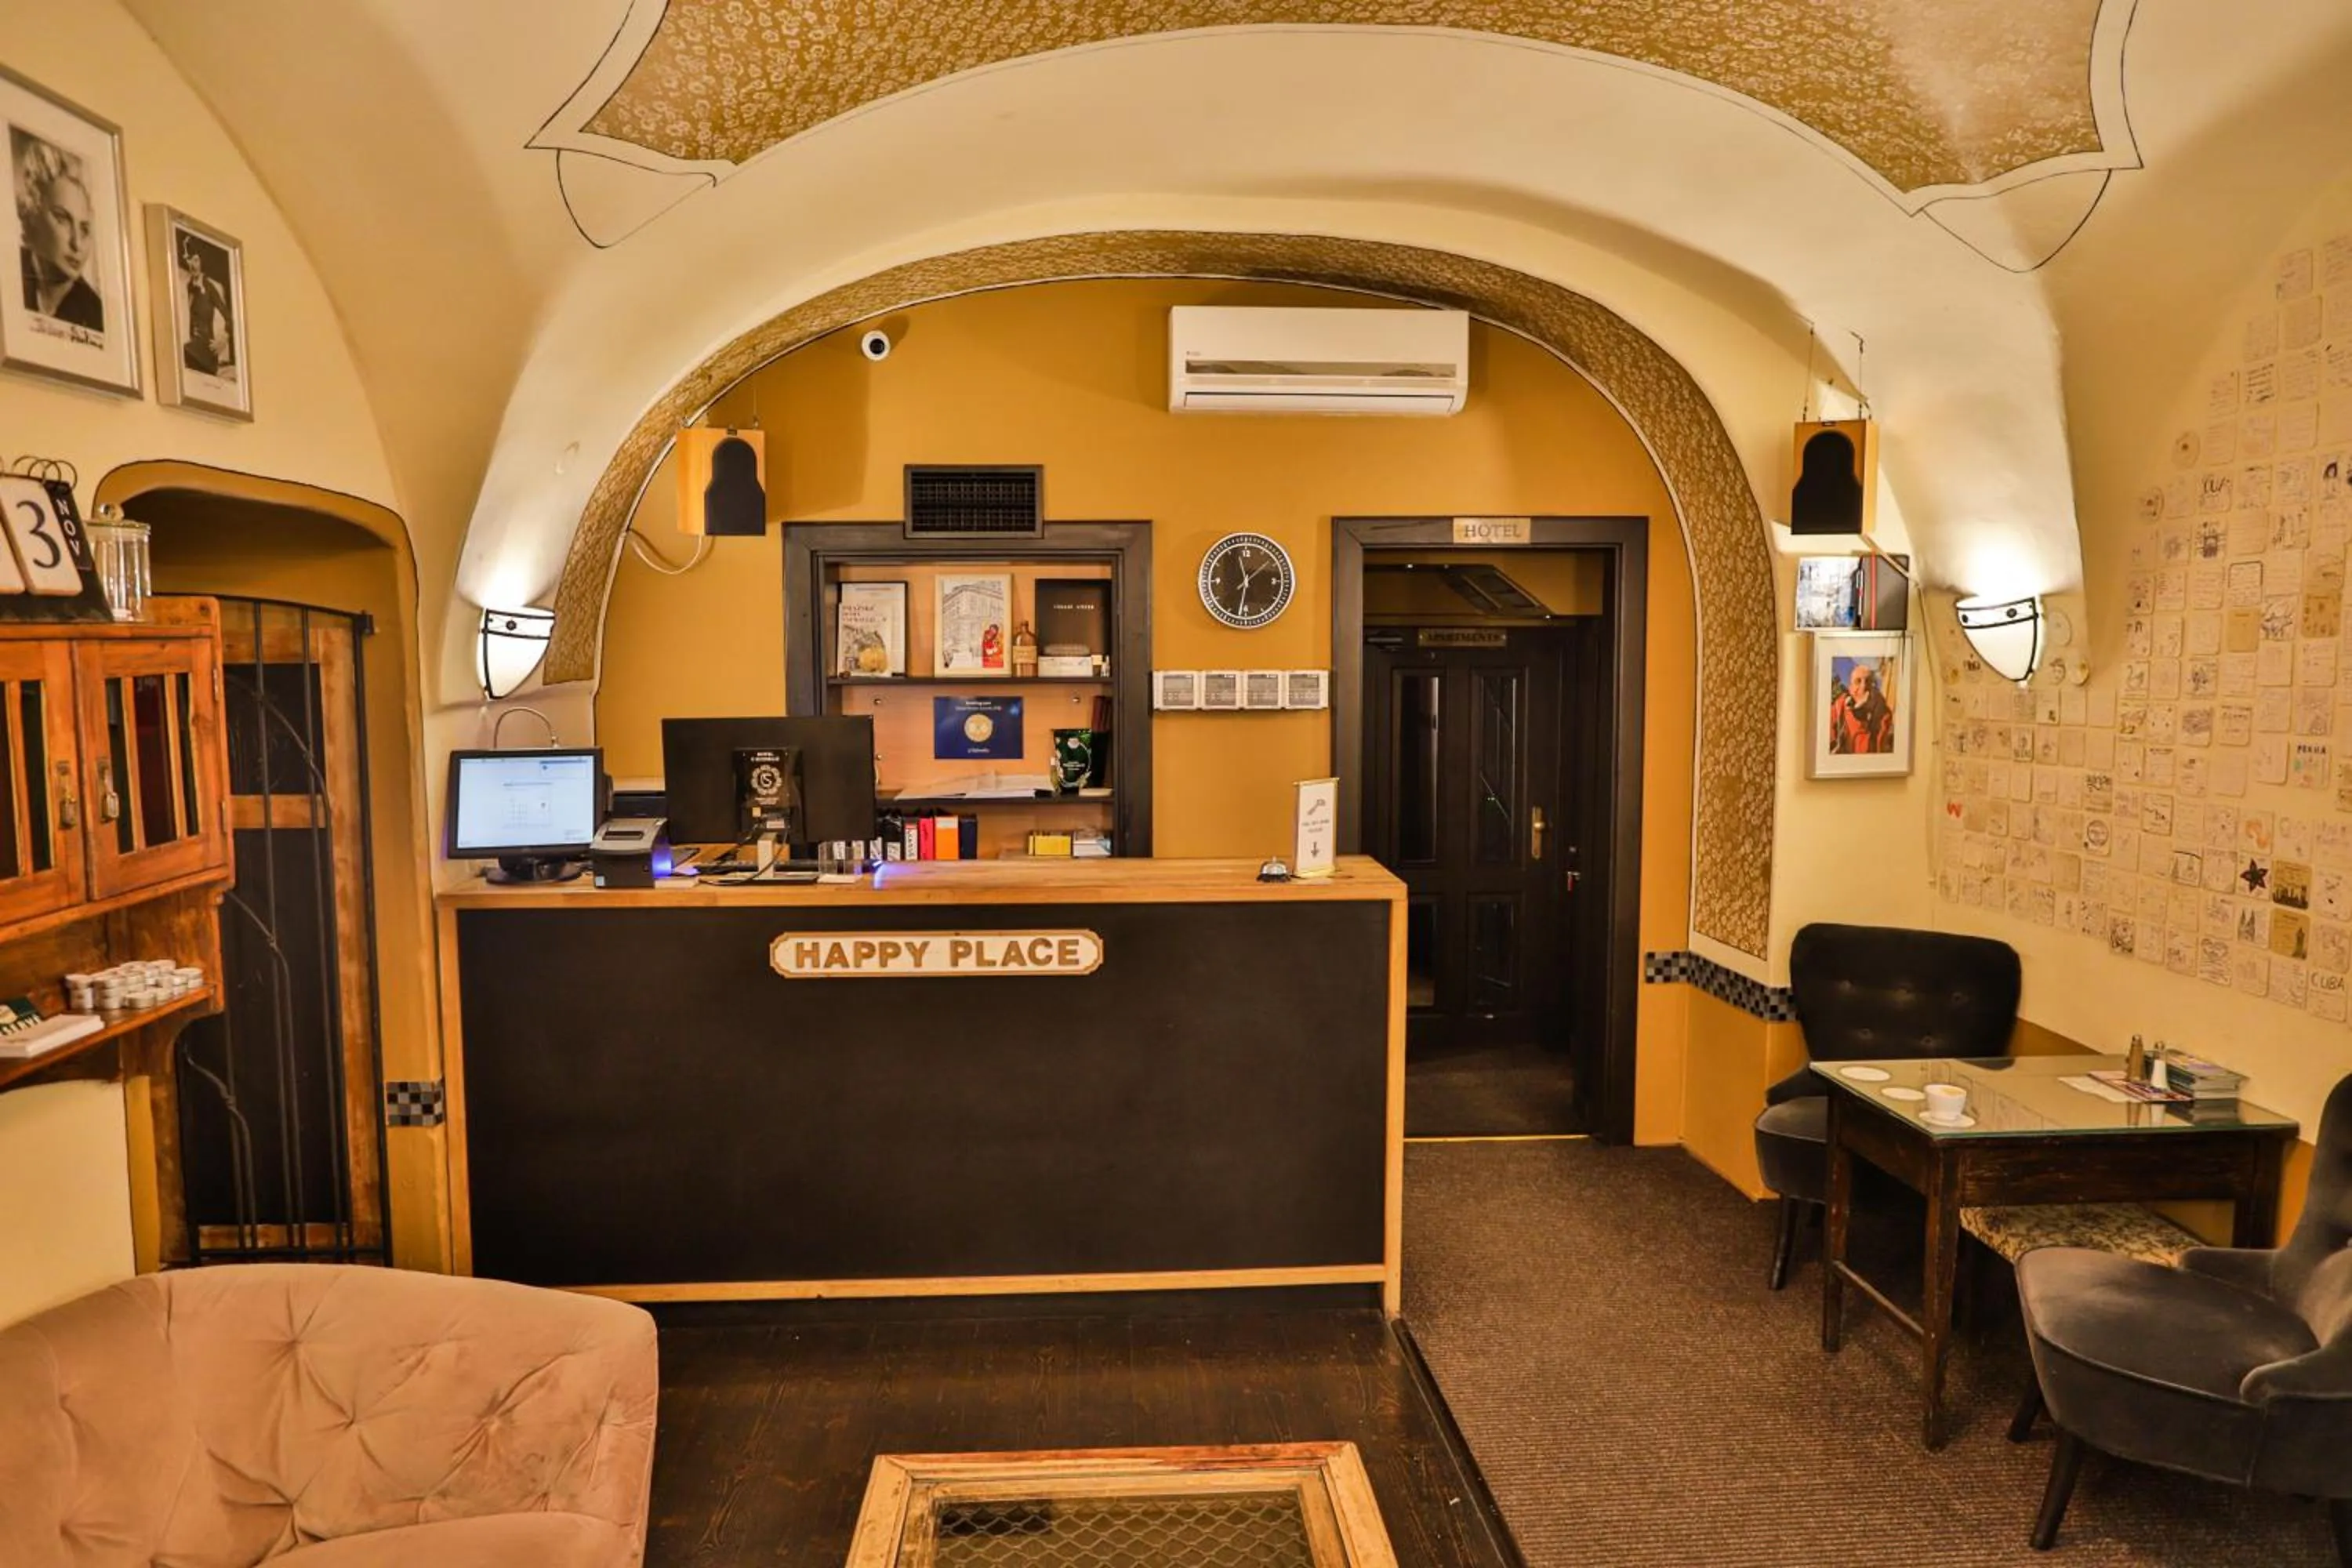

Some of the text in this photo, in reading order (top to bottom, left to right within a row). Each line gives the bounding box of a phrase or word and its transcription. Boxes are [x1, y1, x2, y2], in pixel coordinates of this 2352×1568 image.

[16, 500, 61, 568] 3
[56, 499, 81, 555] NOV
[1464, 524, 1521, 538] HOTEL
[795, 938, 1080, 968] HAPPY PLACE
[2310, 972, 2345, 992] CUBA
